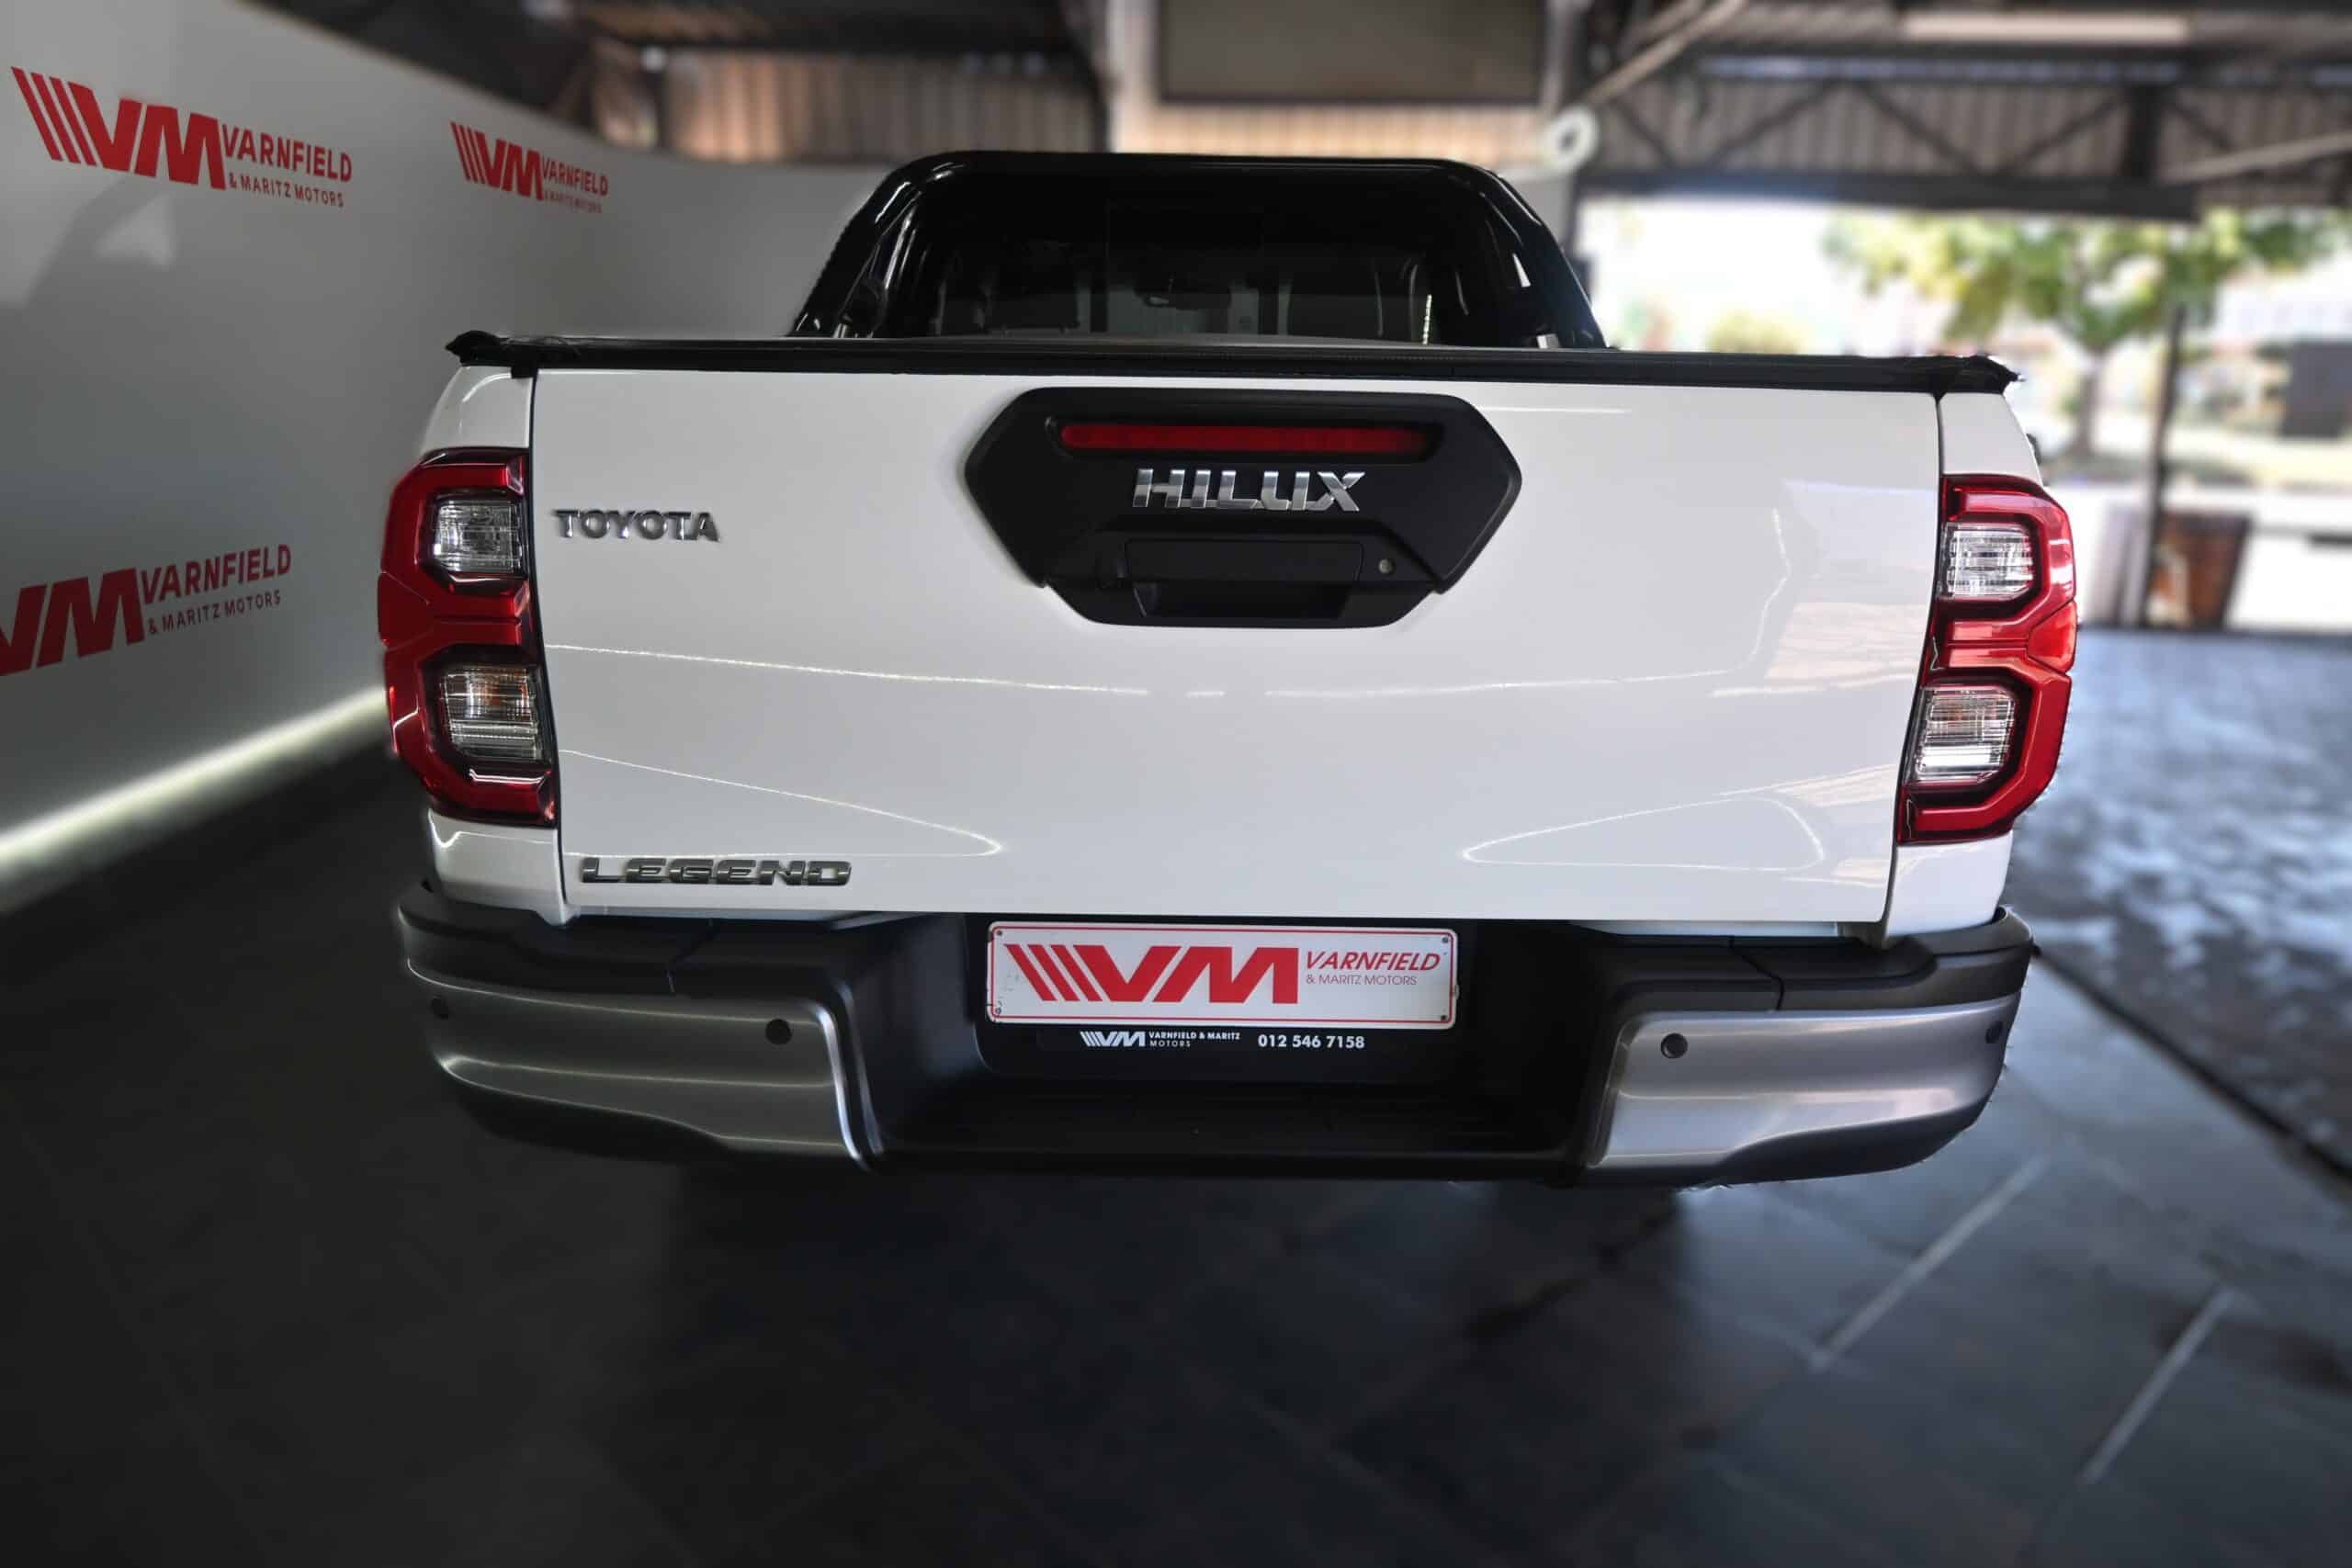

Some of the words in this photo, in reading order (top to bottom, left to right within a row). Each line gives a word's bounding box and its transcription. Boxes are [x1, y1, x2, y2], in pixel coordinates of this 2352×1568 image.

[222, 123, 352, 183] VARNFIELD
[241, 174, 291, 198] MARITZ
[294, 184, 344, 208] MOTORS
[543, 156, 608, 197] VARNFIELD
[1132, 468, 1365, 512] HILUX
[552, 510, 720, 542] TOYOTA
[141, 544, 291, 604] VARNFIELD
[162, 604, 220, 633] MARITZ
[224, 590, 281, 618] MOTORS
[581, 857, 852, 886] LEGEND
[1306, 951, 1441, 971] VARNFIELD
[1306, 975, 1316, 985] &
[1318, 975, 1362, 986] MARITZ
[1364, 975, 1418, 986] MOTORS
[1148, 1032, 1197, 1040] VARNFIELD
[1199, 1032, 1205, 1040] &
[1207, 1032, 1240, 1041] MARITZ
[1258, 1034, 1287, 1047] 012
[1292, 1035, 1321, 1048] 546
[1327, 1035, 1365, 1049] 7158
